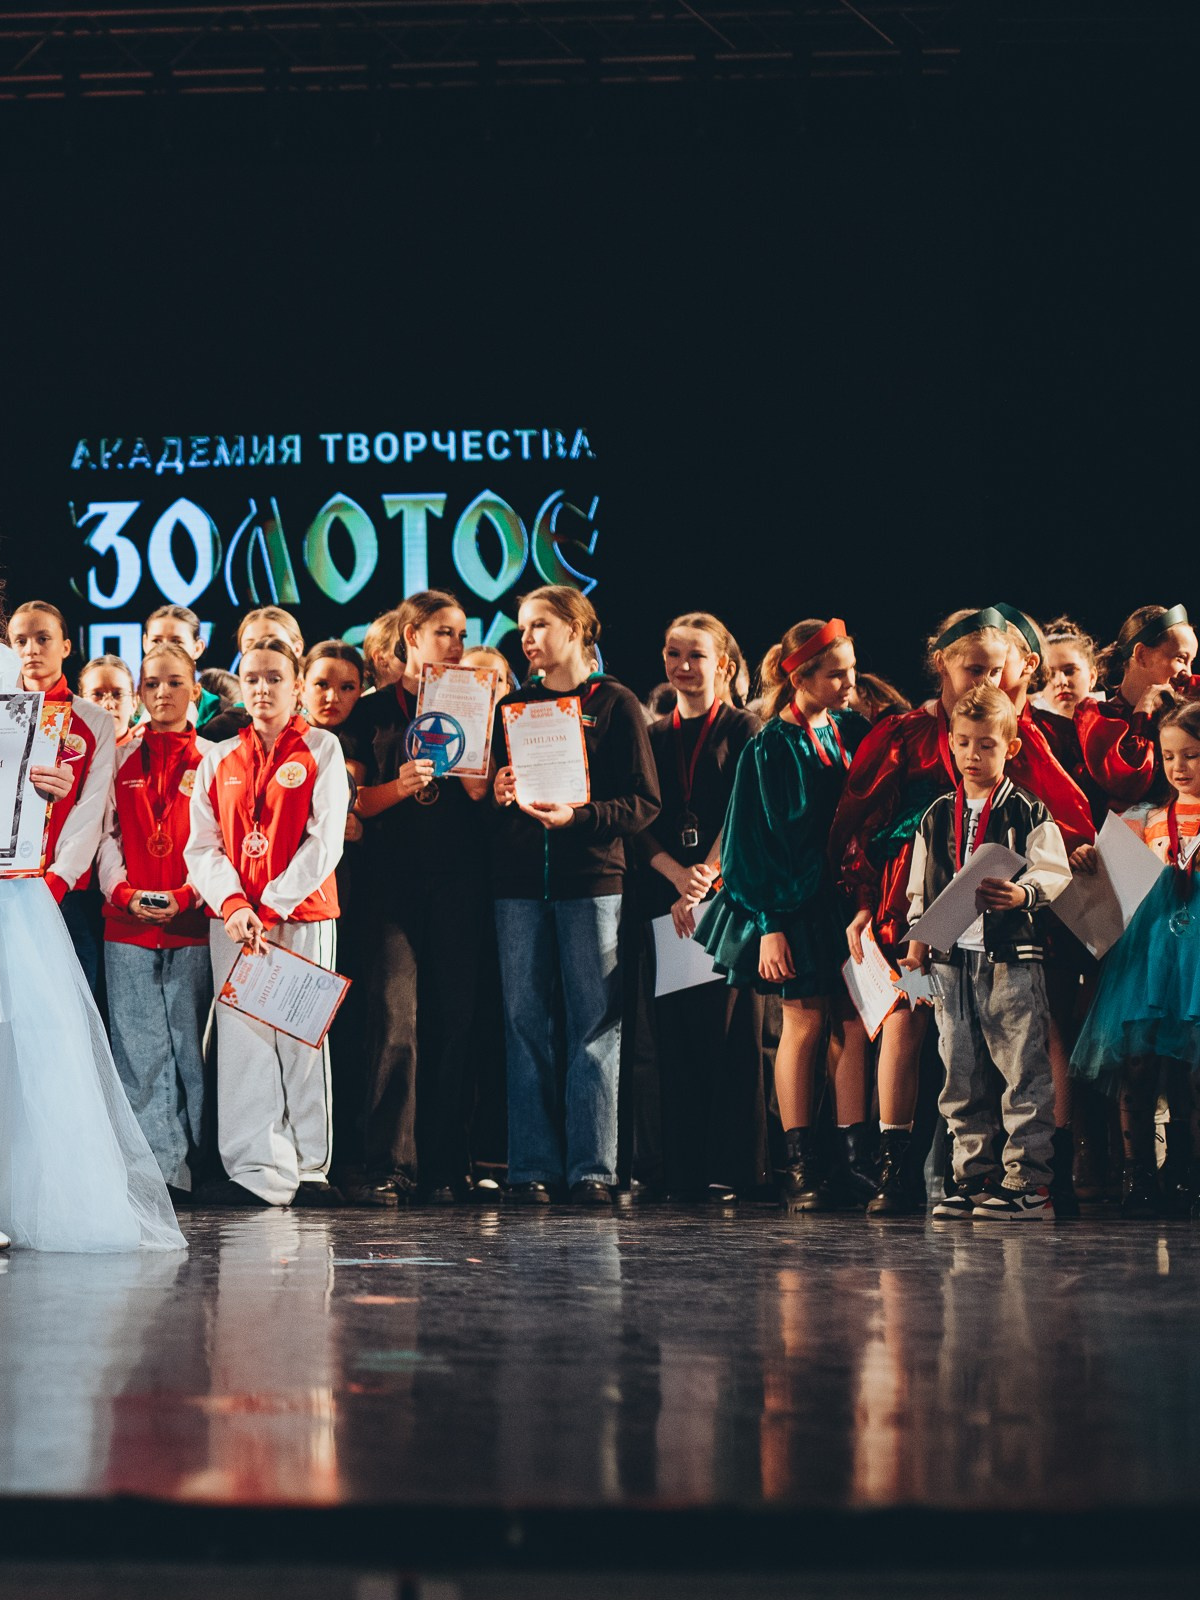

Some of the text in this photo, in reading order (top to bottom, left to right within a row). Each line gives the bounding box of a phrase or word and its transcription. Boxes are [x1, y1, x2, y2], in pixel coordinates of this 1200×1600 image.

[70, 428, 596, 475] АКАДЕМИЯ ТВОРЧЕСТВА
[69, 488, 599, 610] ЗОЛОТОЕ
[523, 735, 567, 746] ДИПЛОМ
